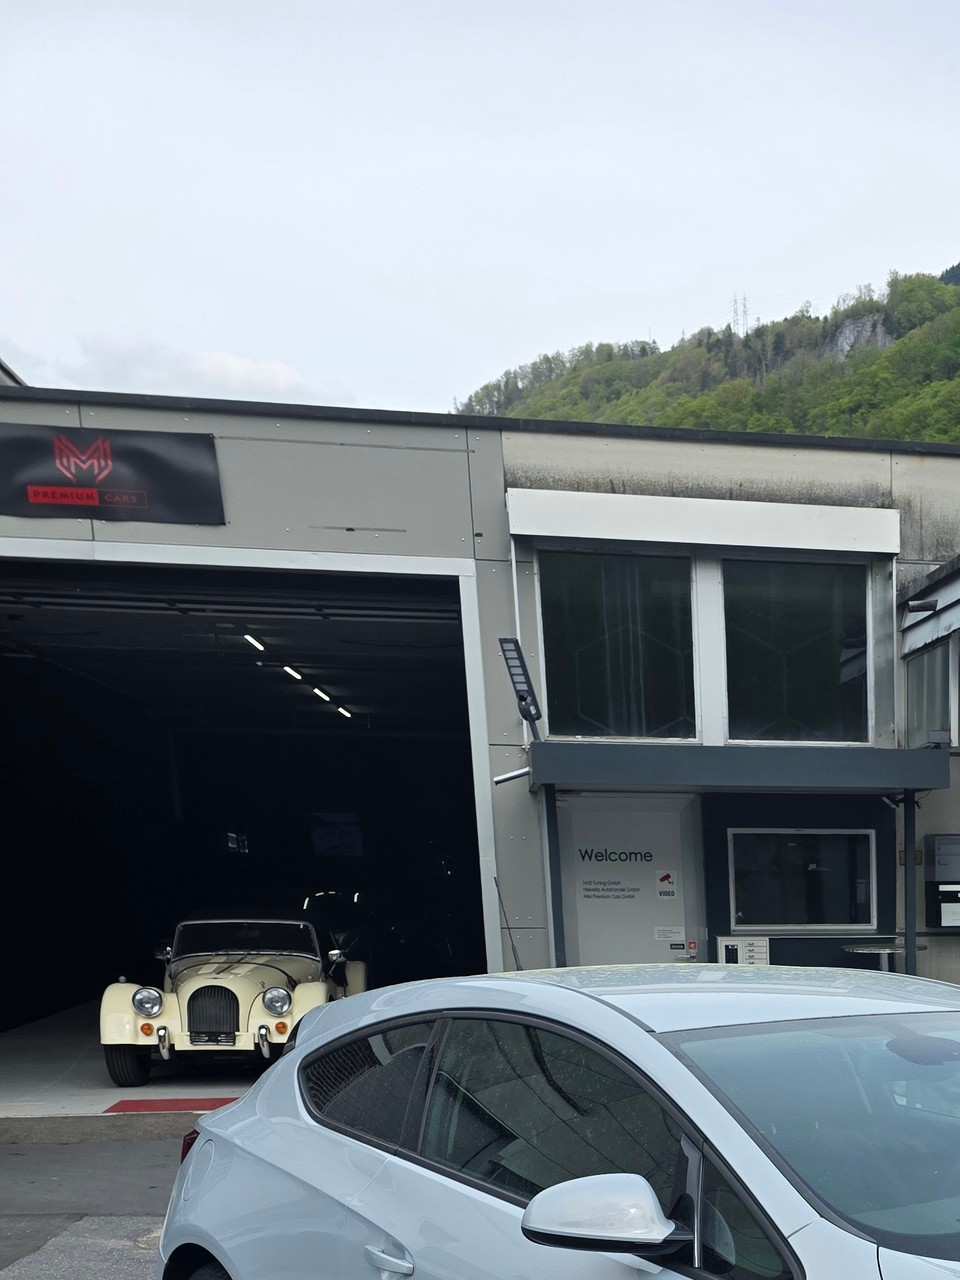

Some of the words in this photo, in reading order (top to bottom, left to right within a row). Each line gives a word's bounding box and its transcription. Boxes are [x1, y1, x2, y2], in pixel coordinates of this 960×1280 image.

[32, 489, 96, 501] PREMIUM
[104, 493, 138, 504] CARS
[579, 848, 653, 862] Welcome
